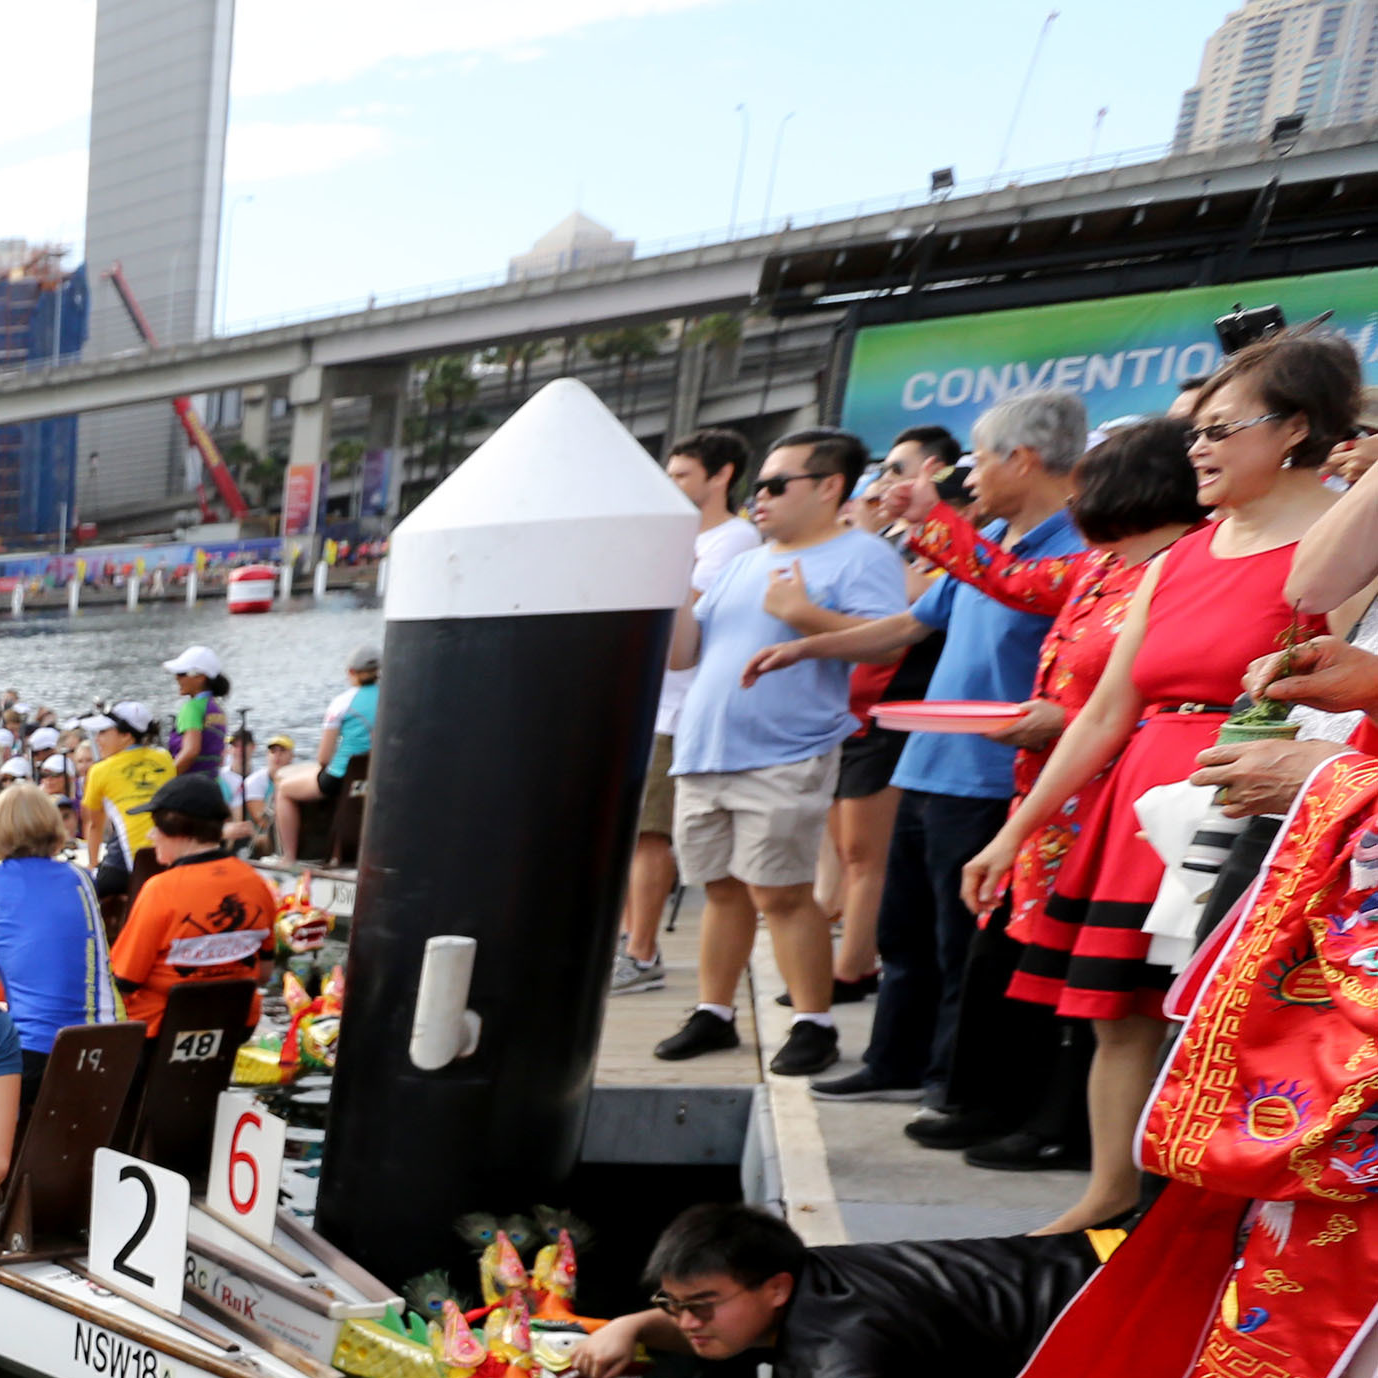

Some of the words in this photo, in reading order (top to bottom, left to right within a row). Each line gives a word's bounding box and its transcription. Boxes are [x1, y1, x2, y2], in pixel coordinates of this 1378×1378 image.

[900, 342, 1223, 411] CONVENTIO
[176, 1032, 217, 1061] 48
[227, 1111, 262, 1216] 6
[112, 1164, 157, 1289] 2
